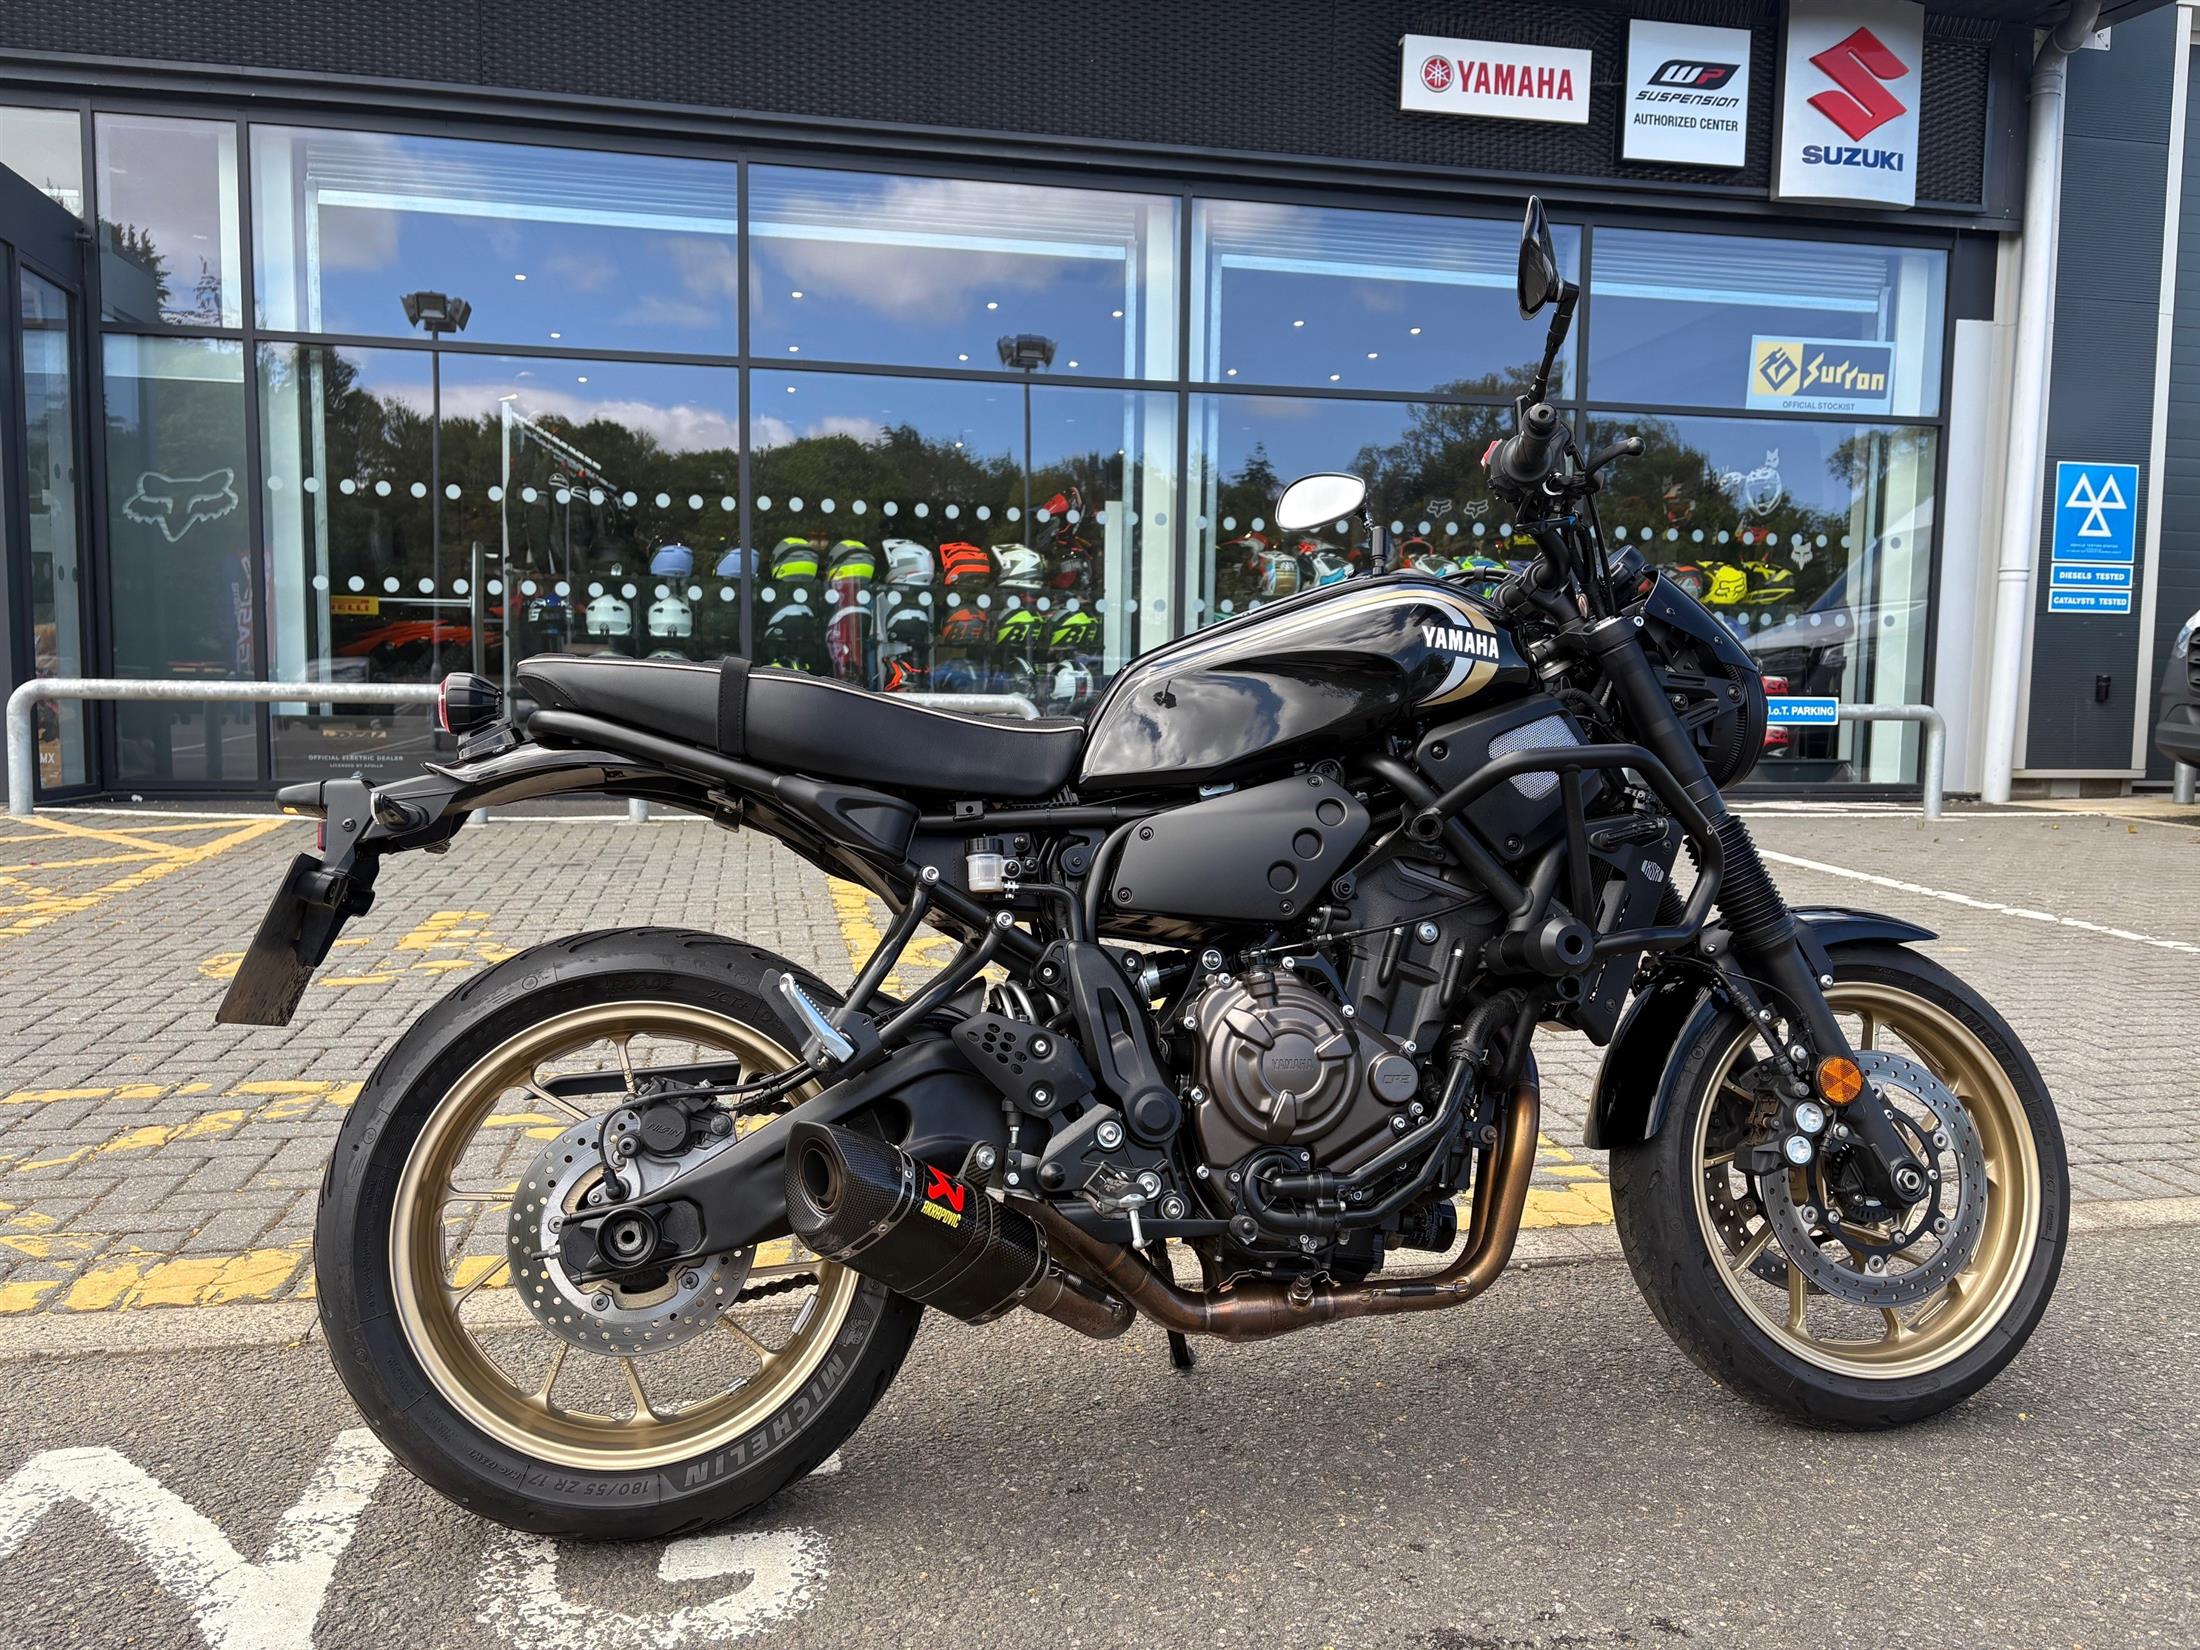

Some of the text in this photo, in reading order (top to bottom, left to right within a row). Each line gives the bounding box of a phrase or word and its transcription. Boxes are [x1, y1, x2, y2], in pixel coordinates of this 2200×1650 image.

[1457, 60, 1574, 101] YAMAHA
[1635, 90, 1740, 107] SUSPENSION
[1633, 112, 1739, 132] AUTHORIZED CENTER
[1801, 145, 1904, 172] SUZUKI
[1803, 352, 1885, 391] Surron
[1782, 401, 1856, 411] OFFICIAL STOCKIST
[2059, 571, 2126, 581] DIESELS TESTED
[2053, 596, 2127, 606] CATALYSTS TESTED
[1421, 625, 1499, 659] YAMAHA
[1791, 706, 1834, 716] PARKING
[1272, 1057, 1314, 1072] YAMAHA
[684, 1352, 847, 1488] MICHELIN
[527, 1470, 550, 1487] 17
[554, 1476, 577, 1493] ZR
[583, 1480, 649, 1496] 180/55
